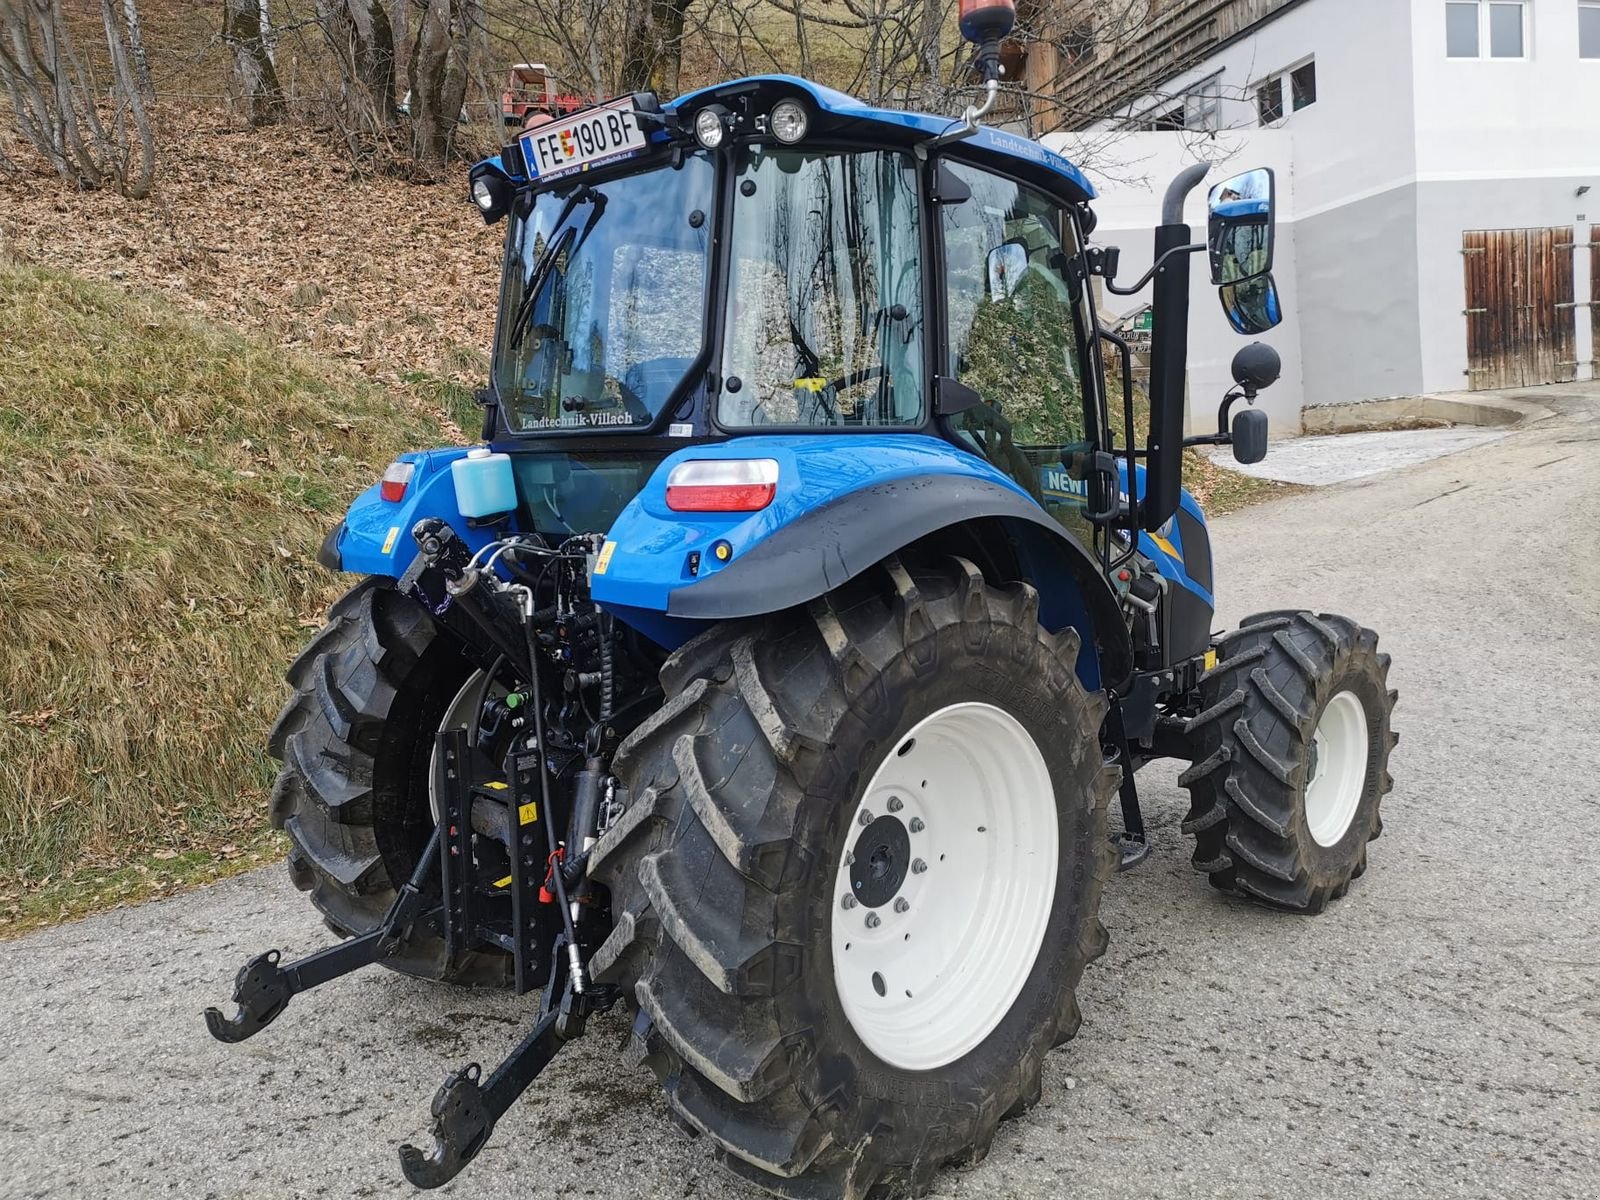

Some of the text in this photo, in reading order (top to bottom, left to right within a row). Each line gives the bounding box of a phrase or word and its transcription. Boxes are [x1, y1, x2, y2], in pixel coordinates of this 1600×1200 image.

[537, 111, 631, 169] FE 190 BF
[530, 162, 537, 172] A
[522, 411, 633, 429] Landtechnik-Villach
[1048, 471, 1081, 494] NEW
